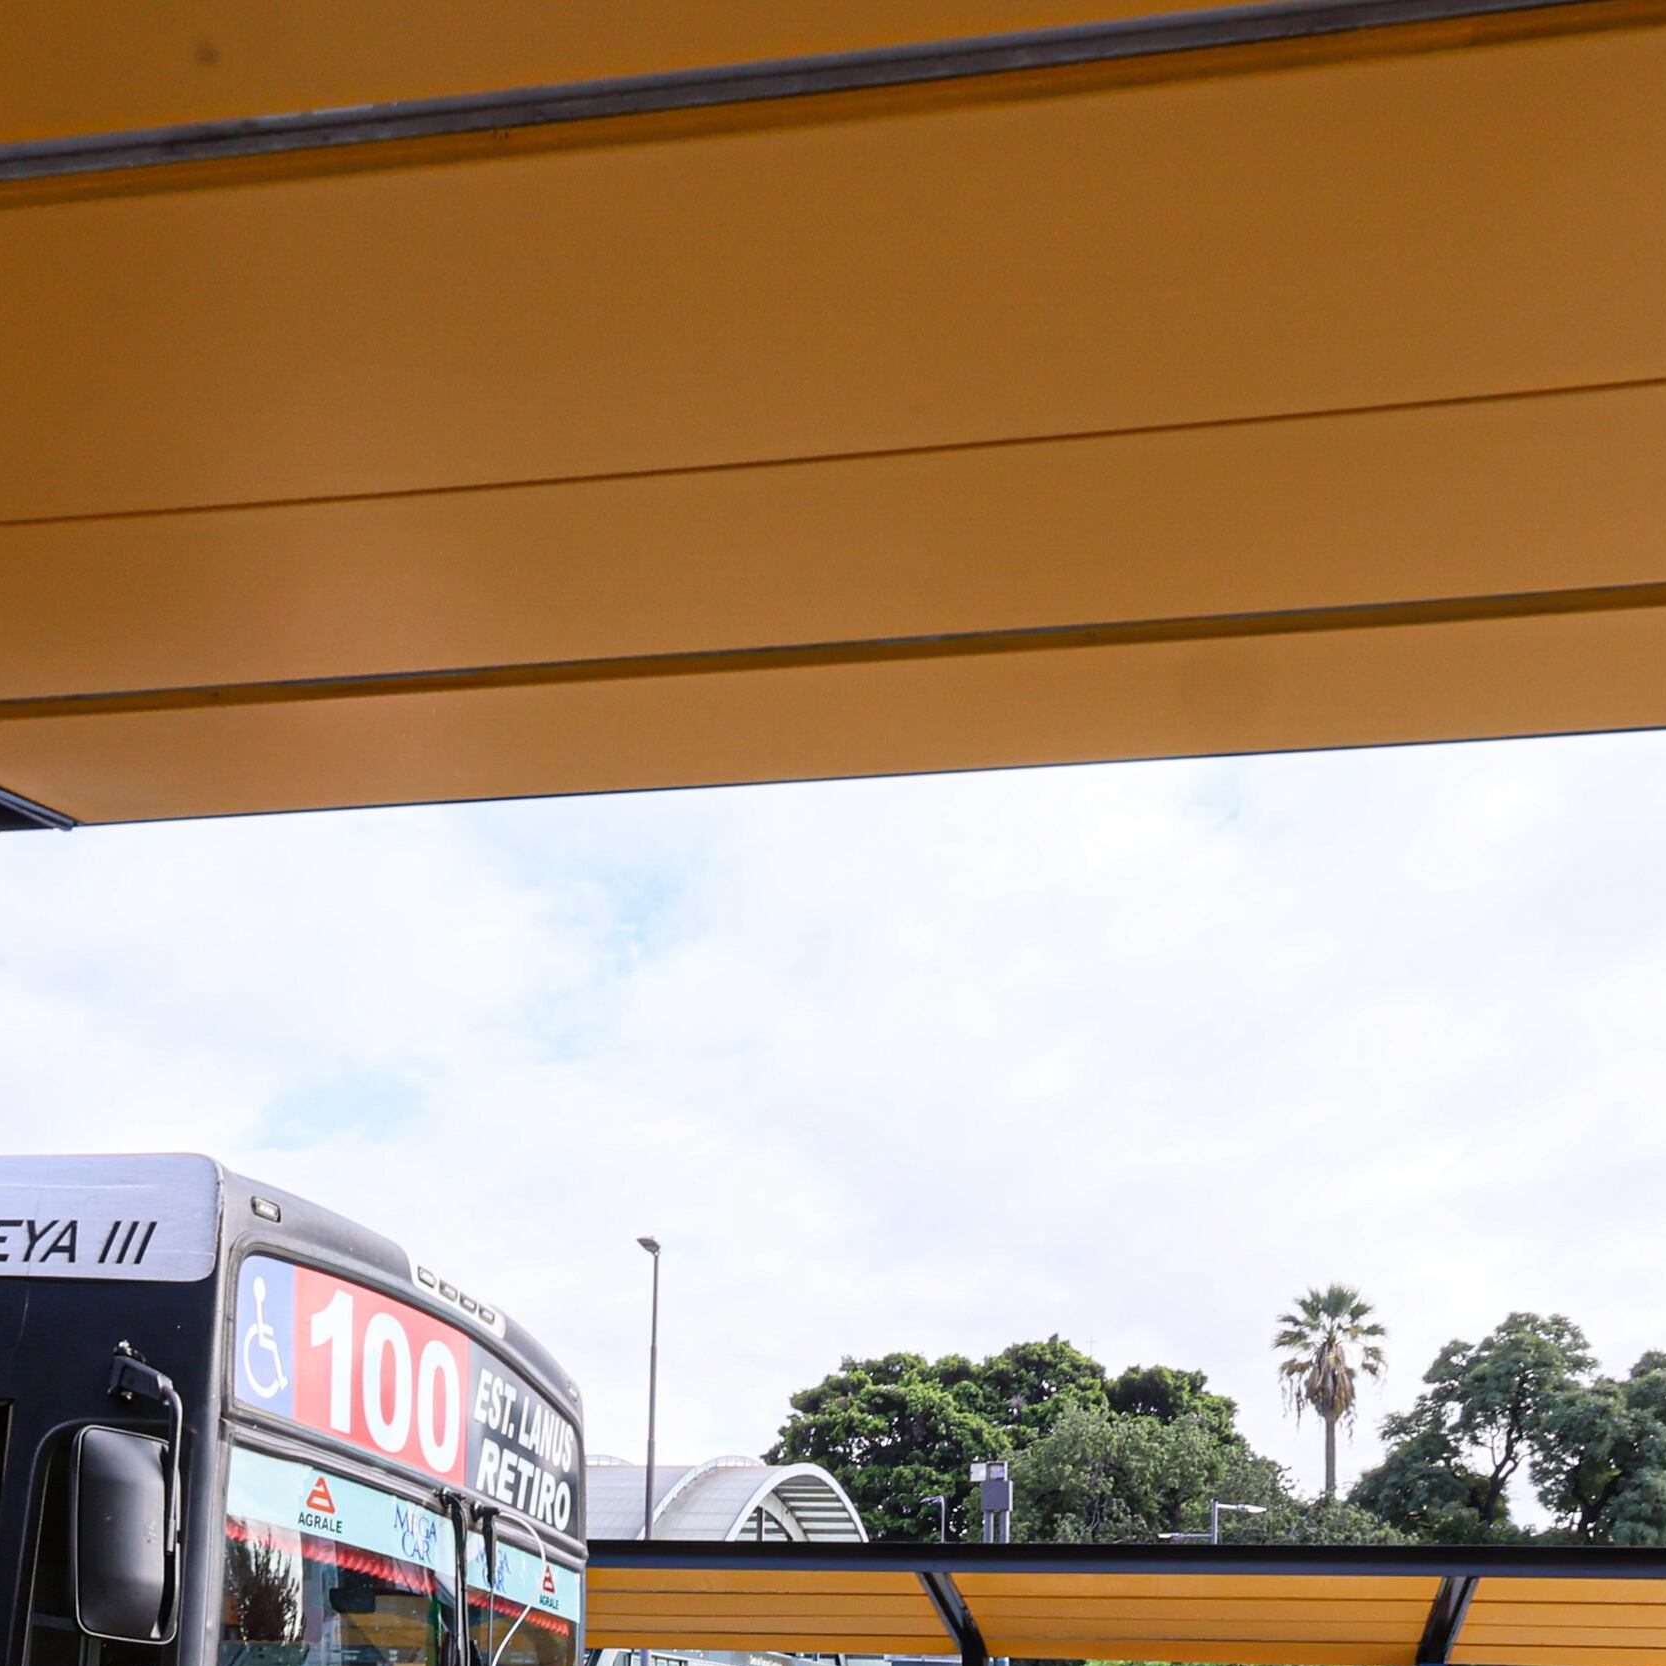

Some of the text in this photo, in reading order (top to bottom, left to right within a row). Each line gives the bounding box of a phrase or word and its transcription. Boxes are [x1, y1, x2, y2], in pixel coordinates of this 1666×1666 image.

[98, 1221, 158, 1265] III
[310, 1289, 461, 1474] 100
[473, 1368, 574, 1473] EST. LANUS
[475, 1438, 571, 1531] RETIRO
[298, 1514, 343, 1534] AGRALE
[539, 1594, 560, 1610] AGRALE
